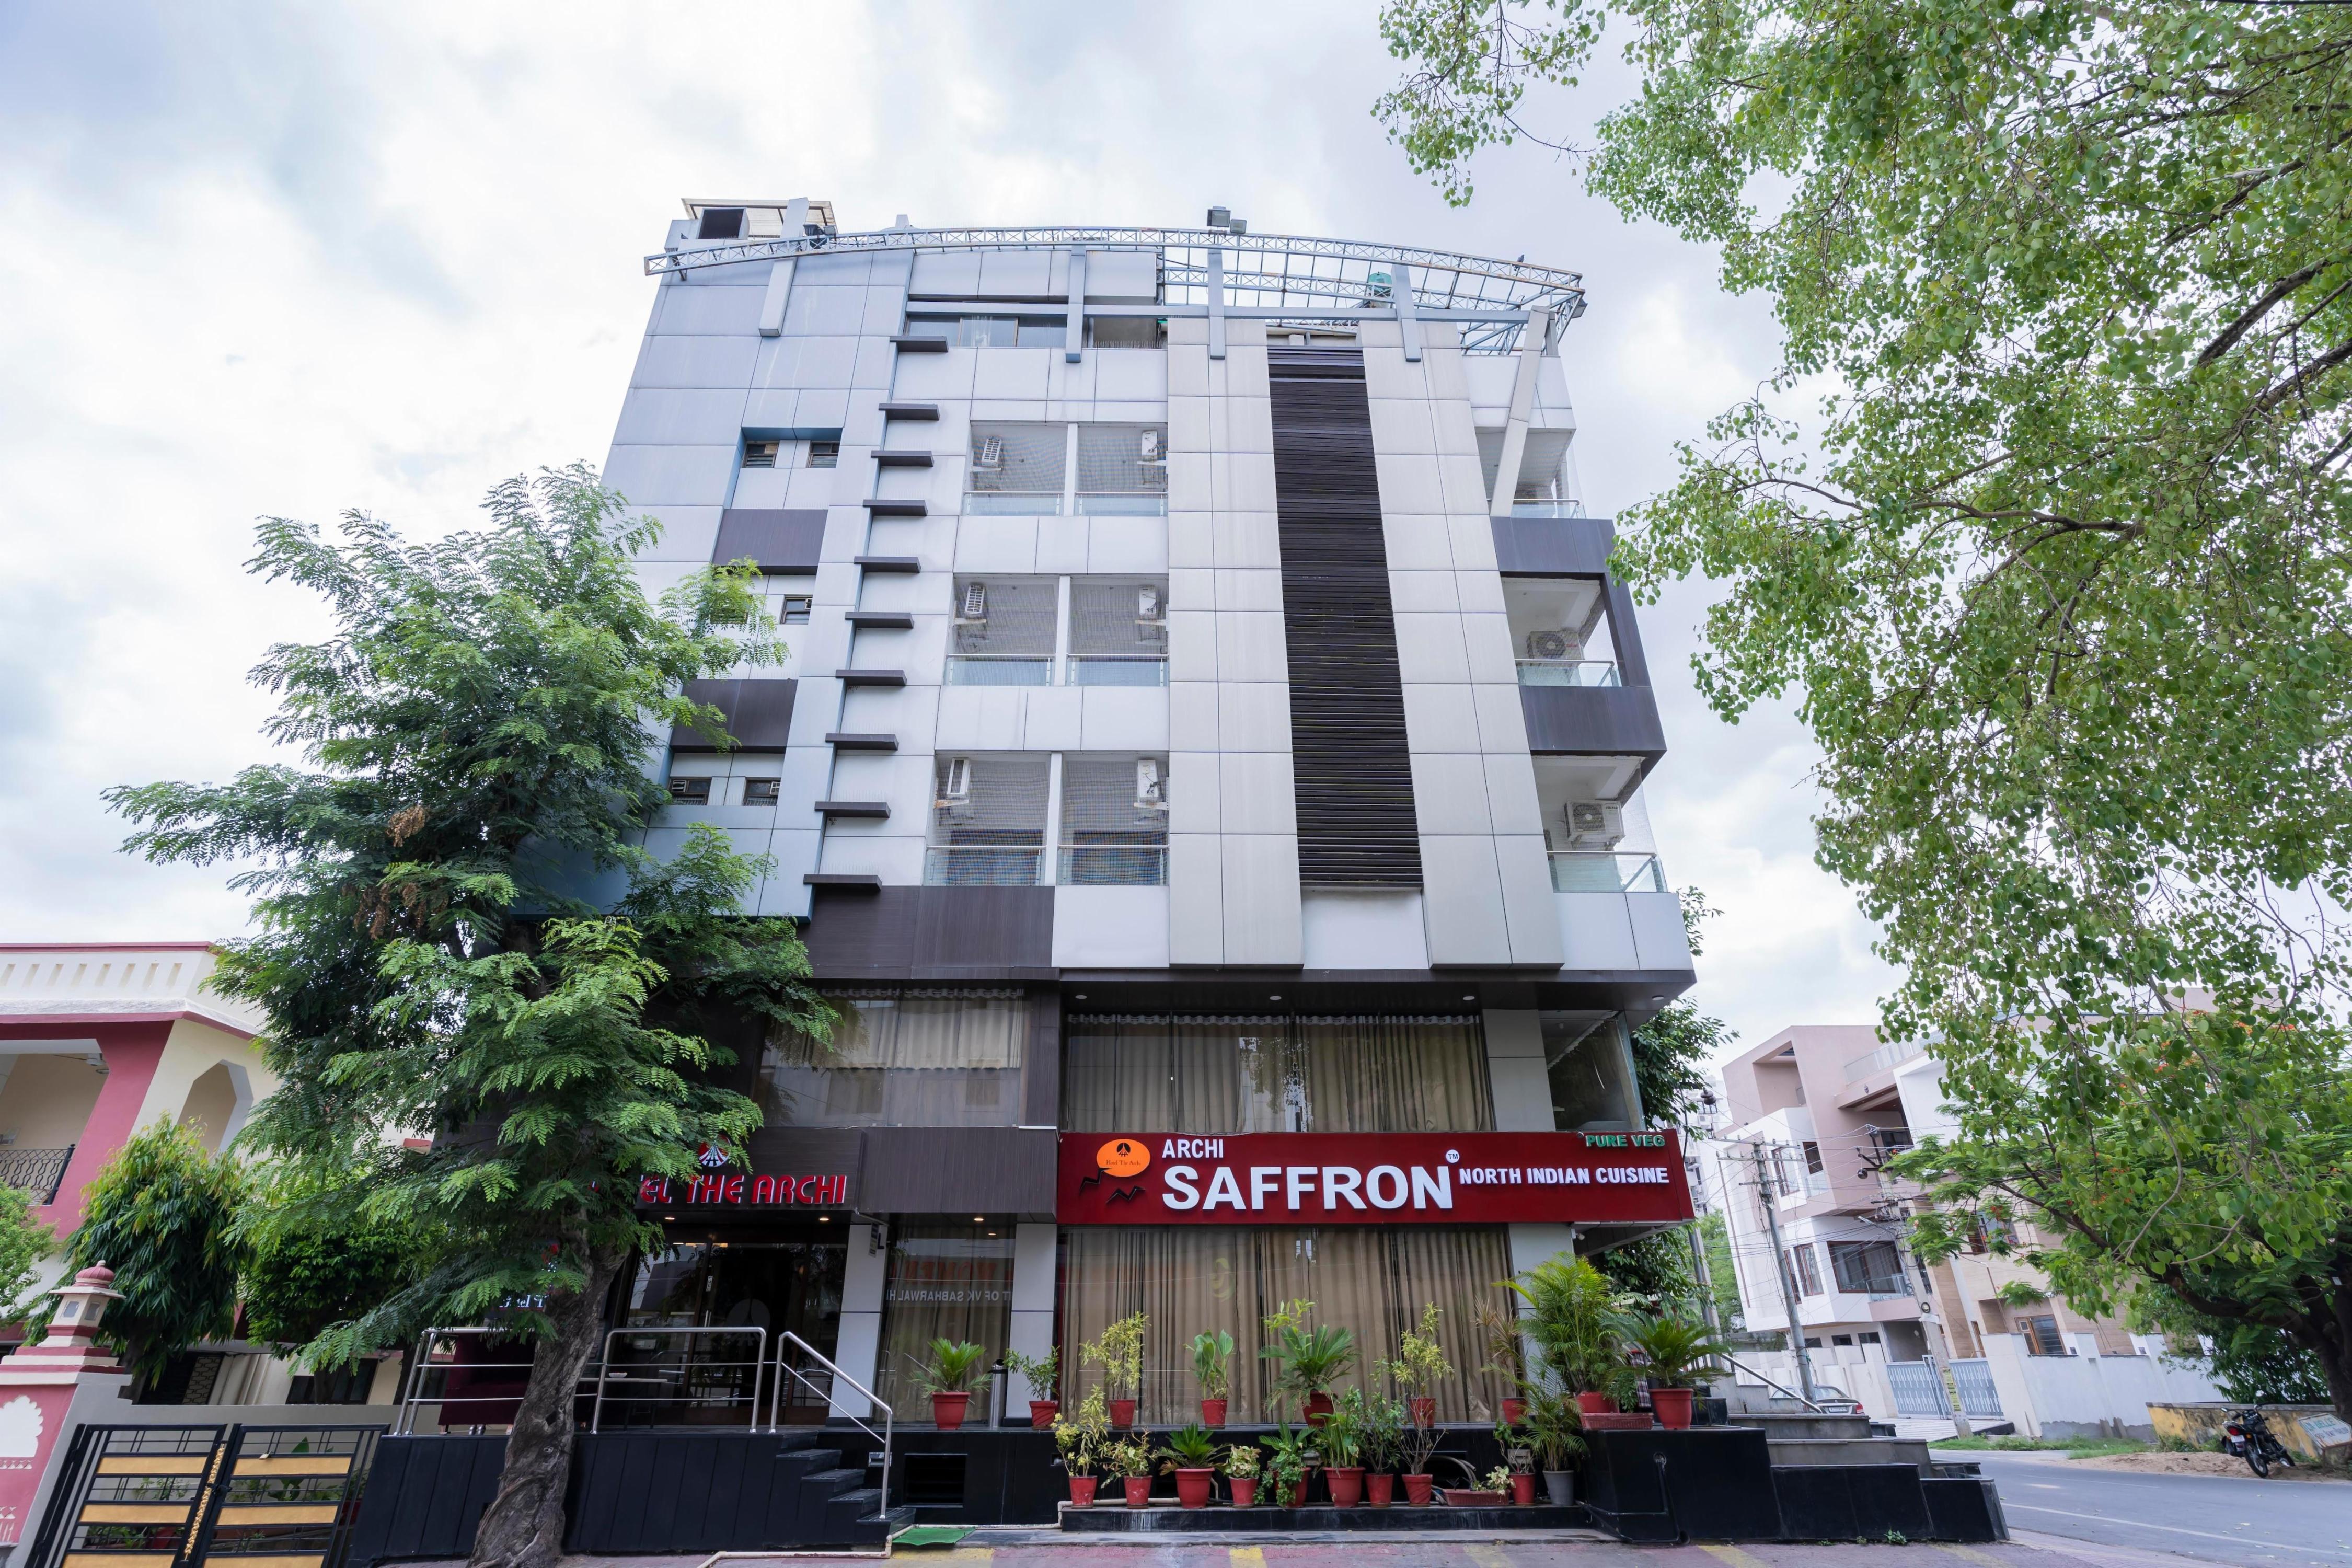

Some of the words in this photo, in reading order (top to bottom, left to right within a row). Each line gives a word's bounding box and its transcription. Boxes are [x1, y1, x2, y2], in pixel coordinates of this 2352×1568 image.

[1162, 1139, 1224, 1159] ARCHI
[1585, 1134, 1628, 1147] PURE
[1631, 1134, 1665, 1147] VEG
[1459, 1168, 1521, 1185] NORTH
[1527, 1167, 1590, 1184] INDIAN
[1595, 1167, 1669, 1184] CUISINE
[686, 1174, 745, 1203] THE
[751, 1174, 847, 1204] ARCHI
[1162, 1165, 1453, 1210] SAFFRON
